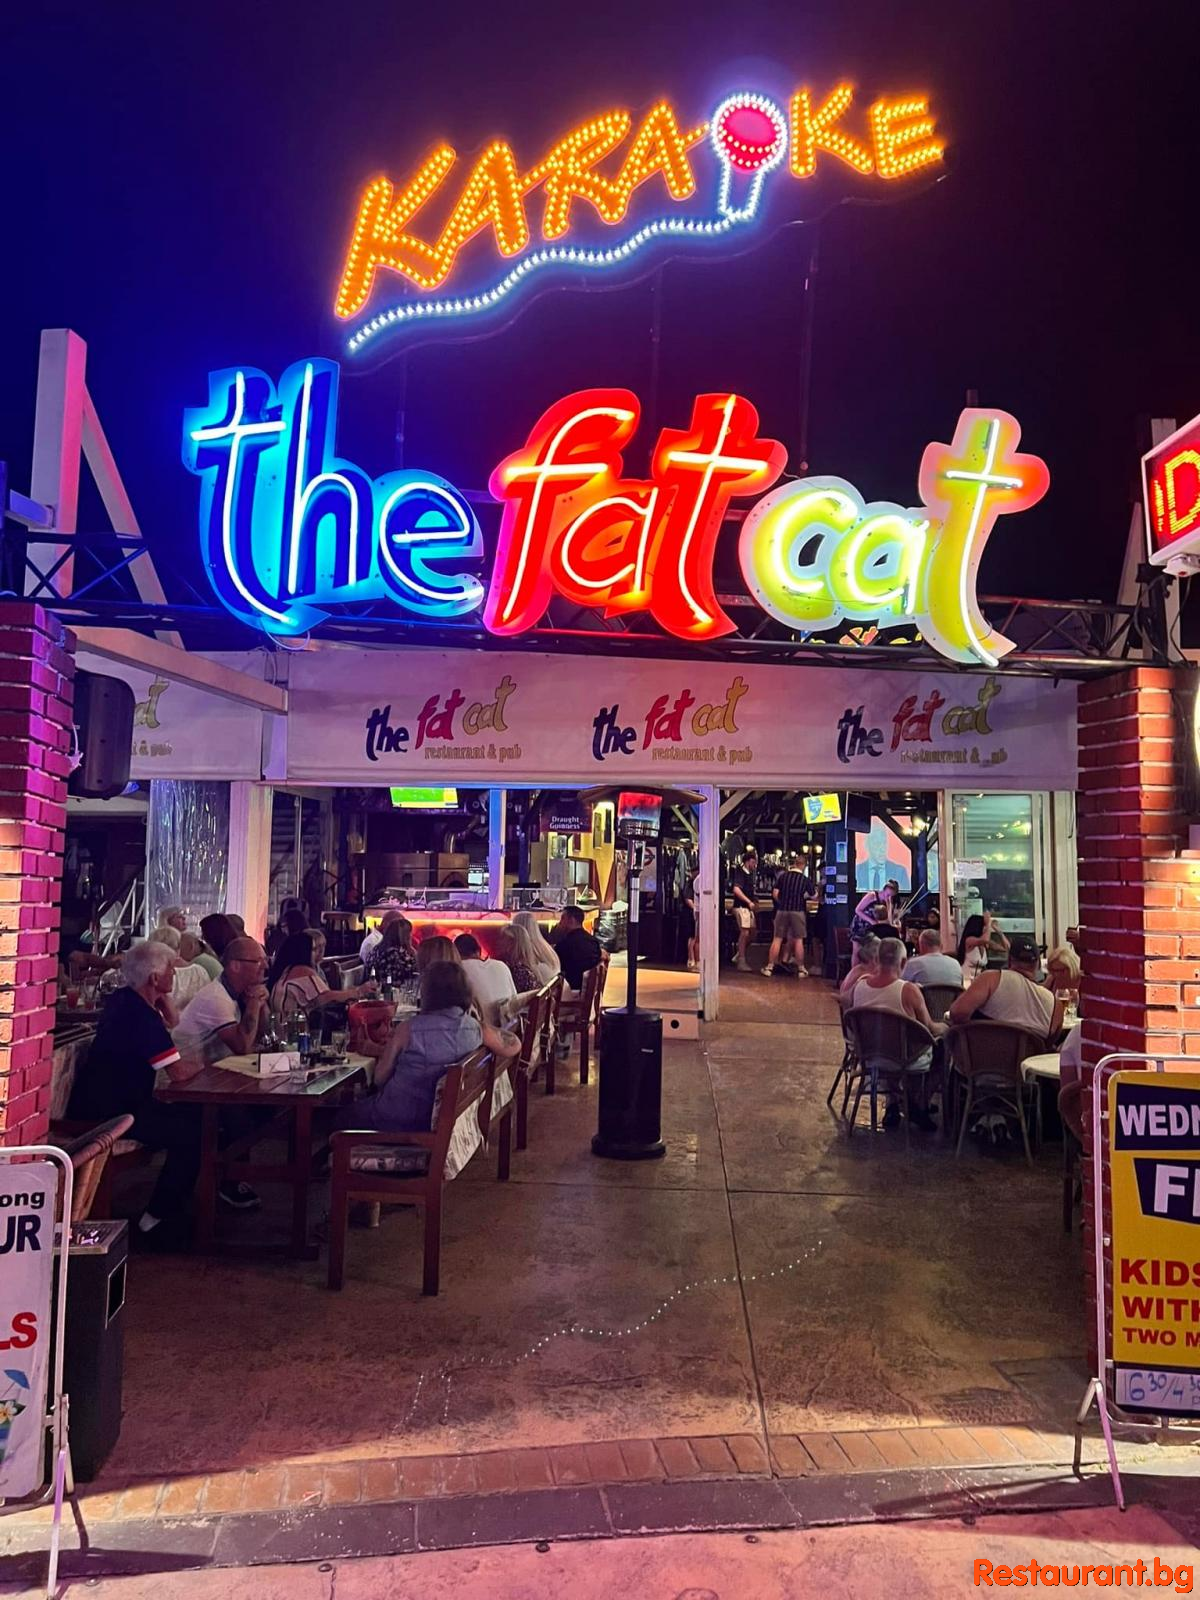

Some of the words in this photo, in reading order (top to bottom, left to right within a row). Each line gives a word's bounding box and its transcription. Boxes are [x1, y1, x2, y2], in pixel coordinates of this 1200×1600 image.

[334, 80, 946, 320] KARAOKE
[183, 357, 486, 638] the
[484, 388, 790, 642] fat
[735, 406, 1051, 668] cat
[366, 704, 409, 761] the
[415, 688, 466, 750] fat
[462, 675, 516, 736] cat
[424, 744, 485, 760] restaurant
[487, 743, 497, 759] &
[499, 743, 522, 763] pub
[592, 704, 637, 761] the
[642, 688, 695, 750] fat
[691, 676, 749, 736] cat
[651, 746, 715, 762] restaurant
[716, 745, 727, 762] &
[729, 746, 753, 765] pub
[837, 705, 884, 763] the
[890, 689, 945, 752] fat
[941, 676, 1002, 735] cat
[0, 1191, 45, 1209] ong
[1122, 1327, 1176, 1346] TWO
